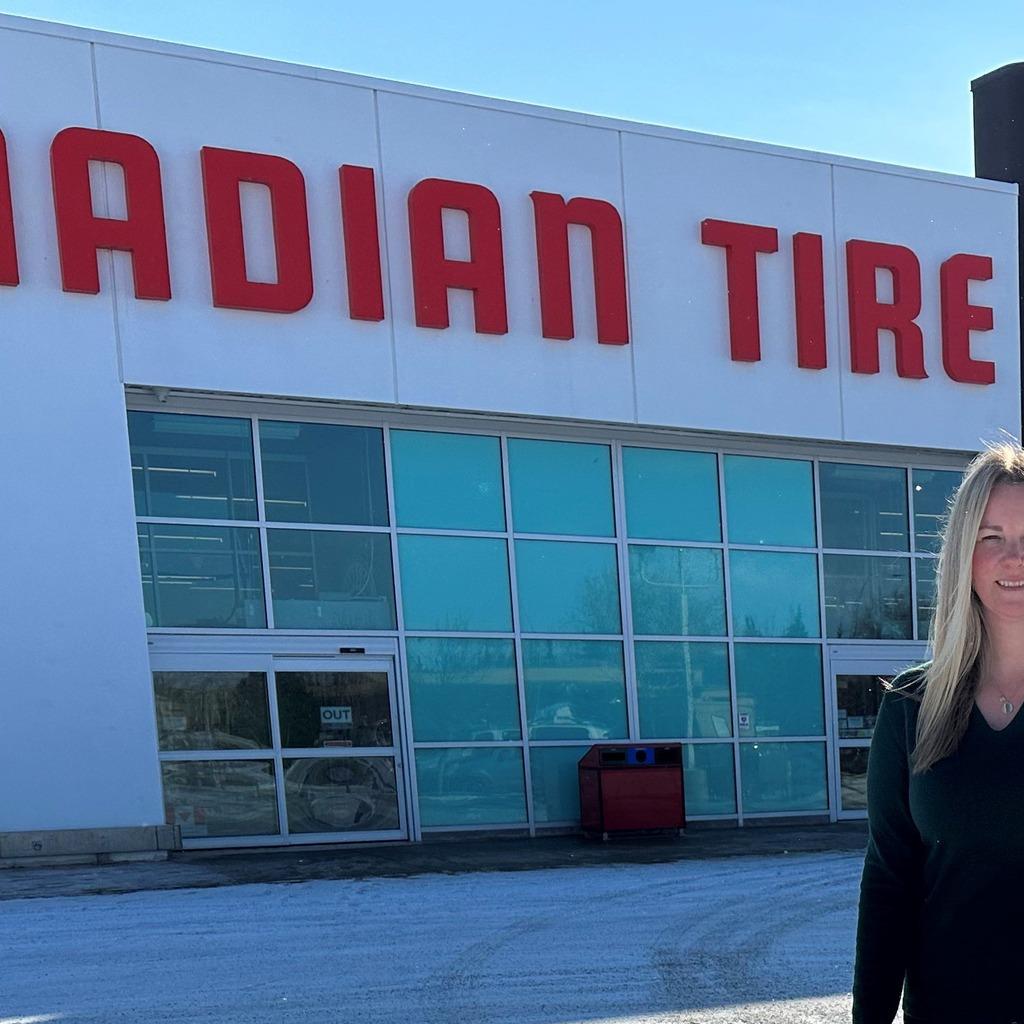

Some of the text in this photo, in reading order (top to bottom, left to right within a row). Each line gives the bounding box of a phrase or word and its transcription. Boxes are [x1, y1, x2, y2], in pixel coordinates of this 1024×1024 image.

[0, 127, 996, 385] ADIAN TIRE
[322, 709, 351, 720] OUT
